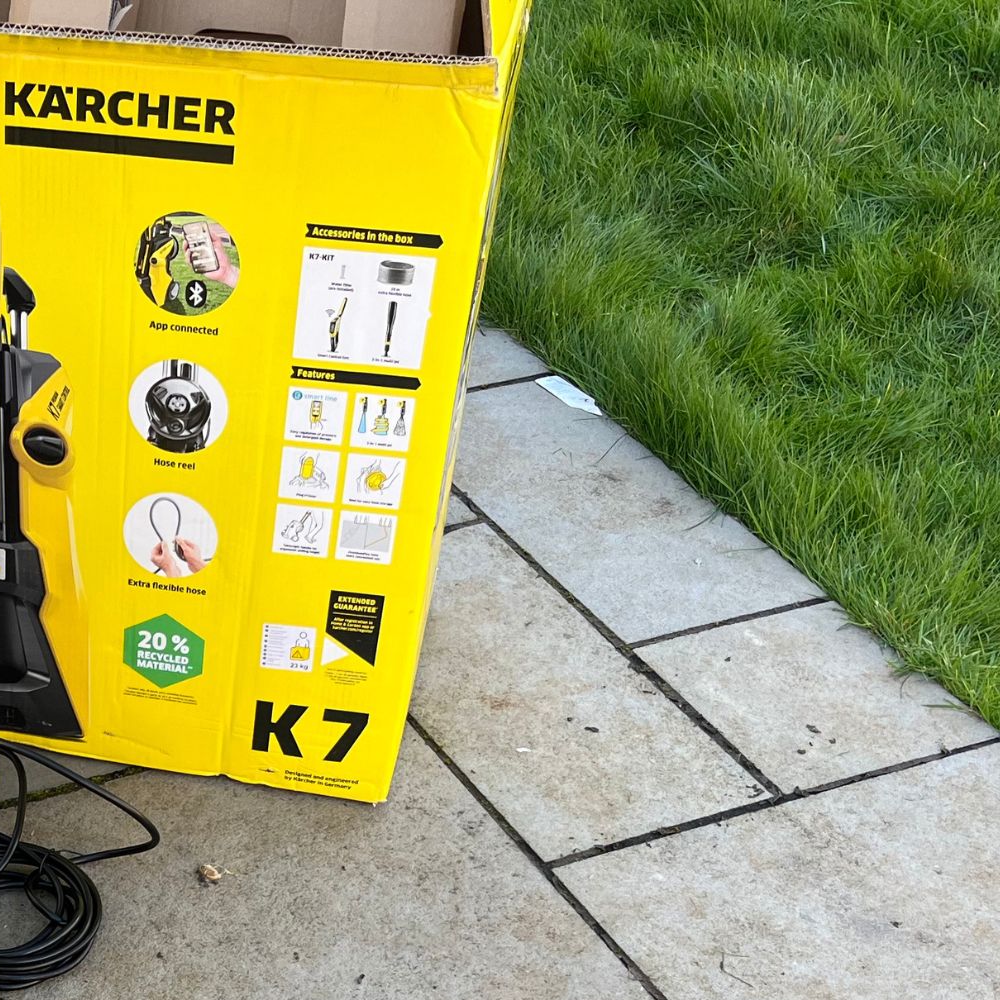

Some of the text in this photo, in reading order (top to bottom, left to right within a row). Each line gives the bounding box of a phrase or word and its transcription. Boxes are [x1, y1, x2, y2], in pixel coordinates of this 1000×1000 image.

[5, 81, 235, 135] KÄRCHER
[312, 226, 413, 244] Accessories in the box
[309, 252, 335, 262] K7-KIT
[149, 320, 219, 336] App connected
[297, 368, 336, 380] Features
[154, 457, 196, 470] Hose reel
[127, 578, 207, 596] Extra flexible hose
[338, 596, 376, 605] EXTENDED
[138, 630, 190, 655] 20 %
[137, 650, 189, 665] RECYCLED
[251, 699, 370, 763] K 7
[284, 769, 312, 779] Designed
[325, 776, 359, 785] engineered
[324, 781, 352, 790] Germany
